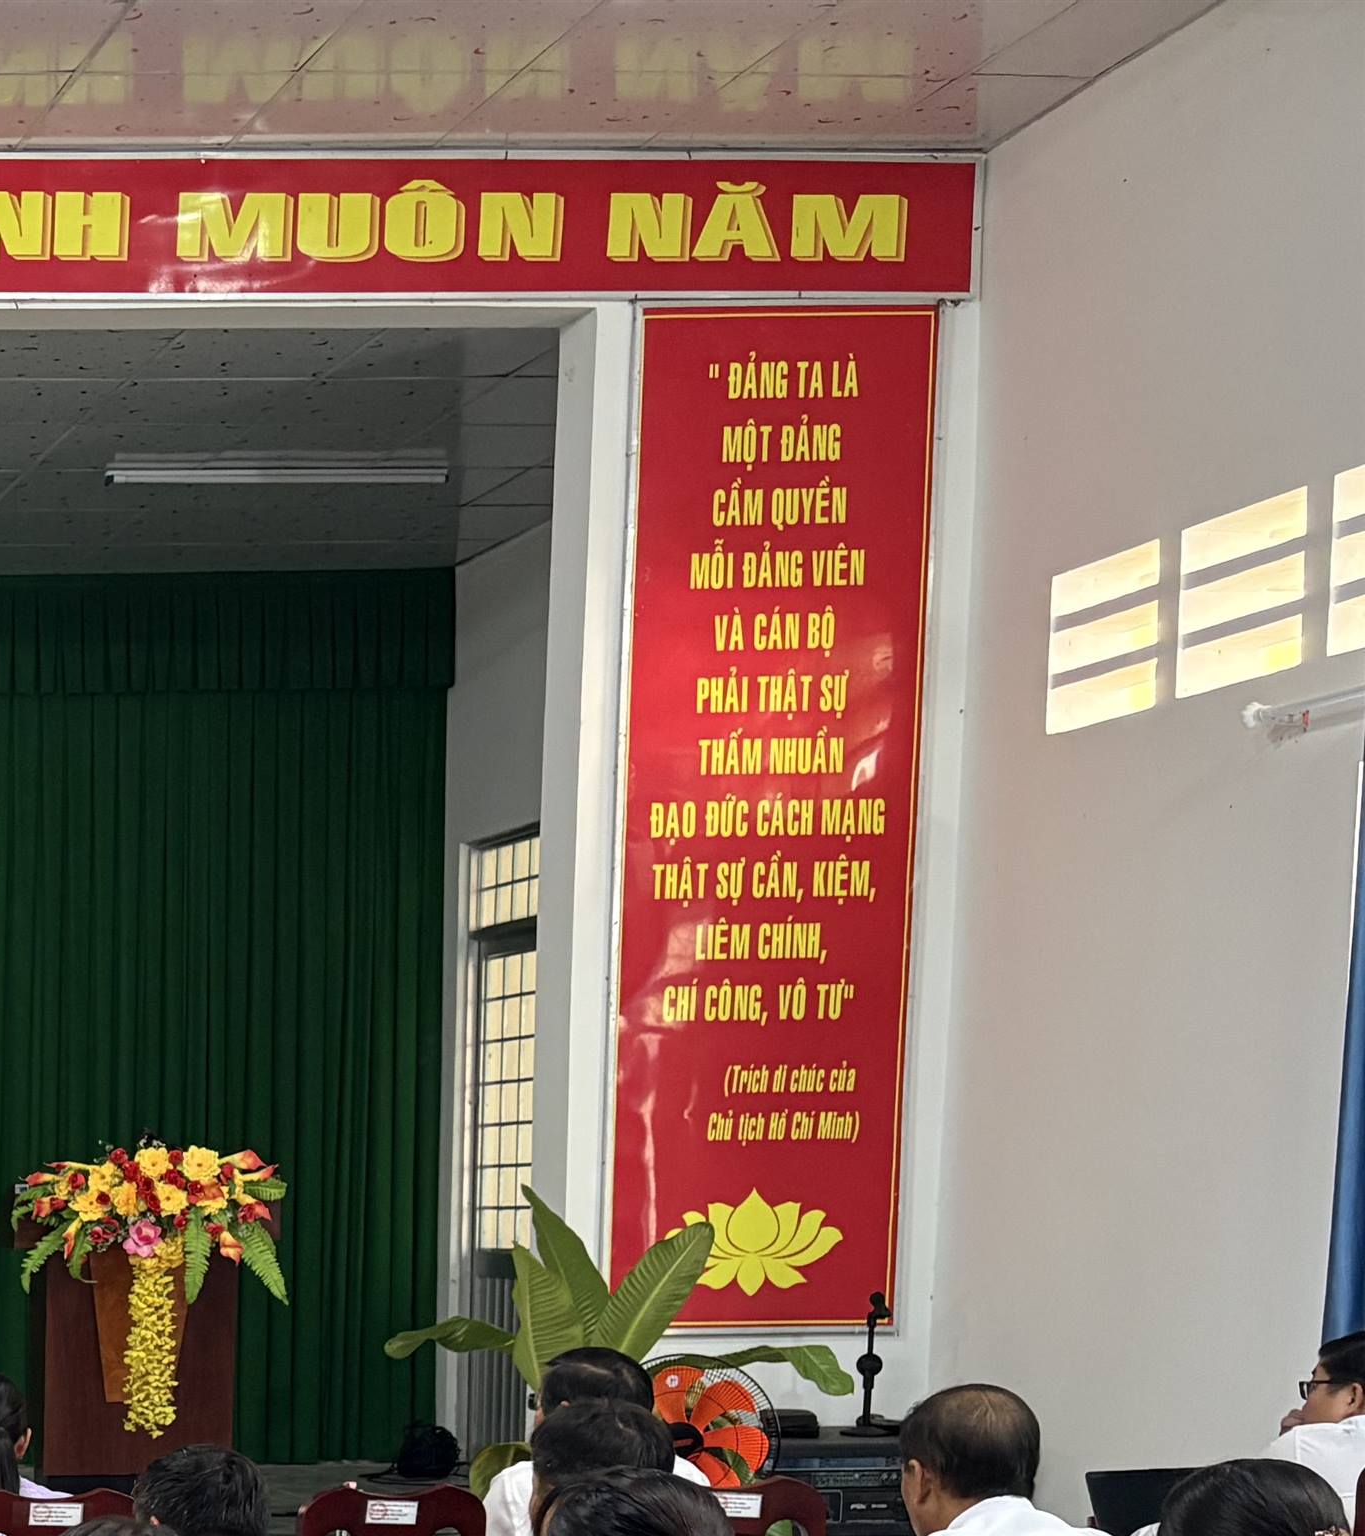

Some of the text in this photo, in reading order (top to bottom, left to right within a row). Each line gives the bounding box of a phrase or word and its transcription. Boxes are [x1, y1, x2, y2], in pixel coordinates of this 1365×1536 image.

[176, 179, 563, 262] MUÔN
[607, 181, 906, 261] NĂM
[727, 351, 789, 400] ĐẢNG
[796, 360, 824, 399] TA
[831, 355, 859, 398] LÀ
[721, 415, 842, 471] MỘT ĐẢNG
[712, 476, 847, 531] CẦM QUYỀN
[689, 538, 865, 590] MỖI ĐẢNG VIÊN
[714, 605, 836, 658] VÀ CÁN BỘ
[696, 665, 850, 721] PHẢI THẬT SỰ
[698, 725, 845, 776] THẤM NHUẦN
[649, 791, 886, 847] ĐẠO ĐỨC CÁCH MẠNG
[651, 850, 876, 909] THẬT SỰ CẦN, KIỆM,
[693, 915, 828, 965] LIÊM CHÍNH,
[662, 977, 698, 1026] CHÍ
[703, 979, 768, 1026] CÔNG,
[778, 976, 807, 1021] VÔ
[724, 1060, 856, 1098] (Trích di chúc của
[706, 1110, 860, 1143] Chủ tịch Hồ Chí Minh)
